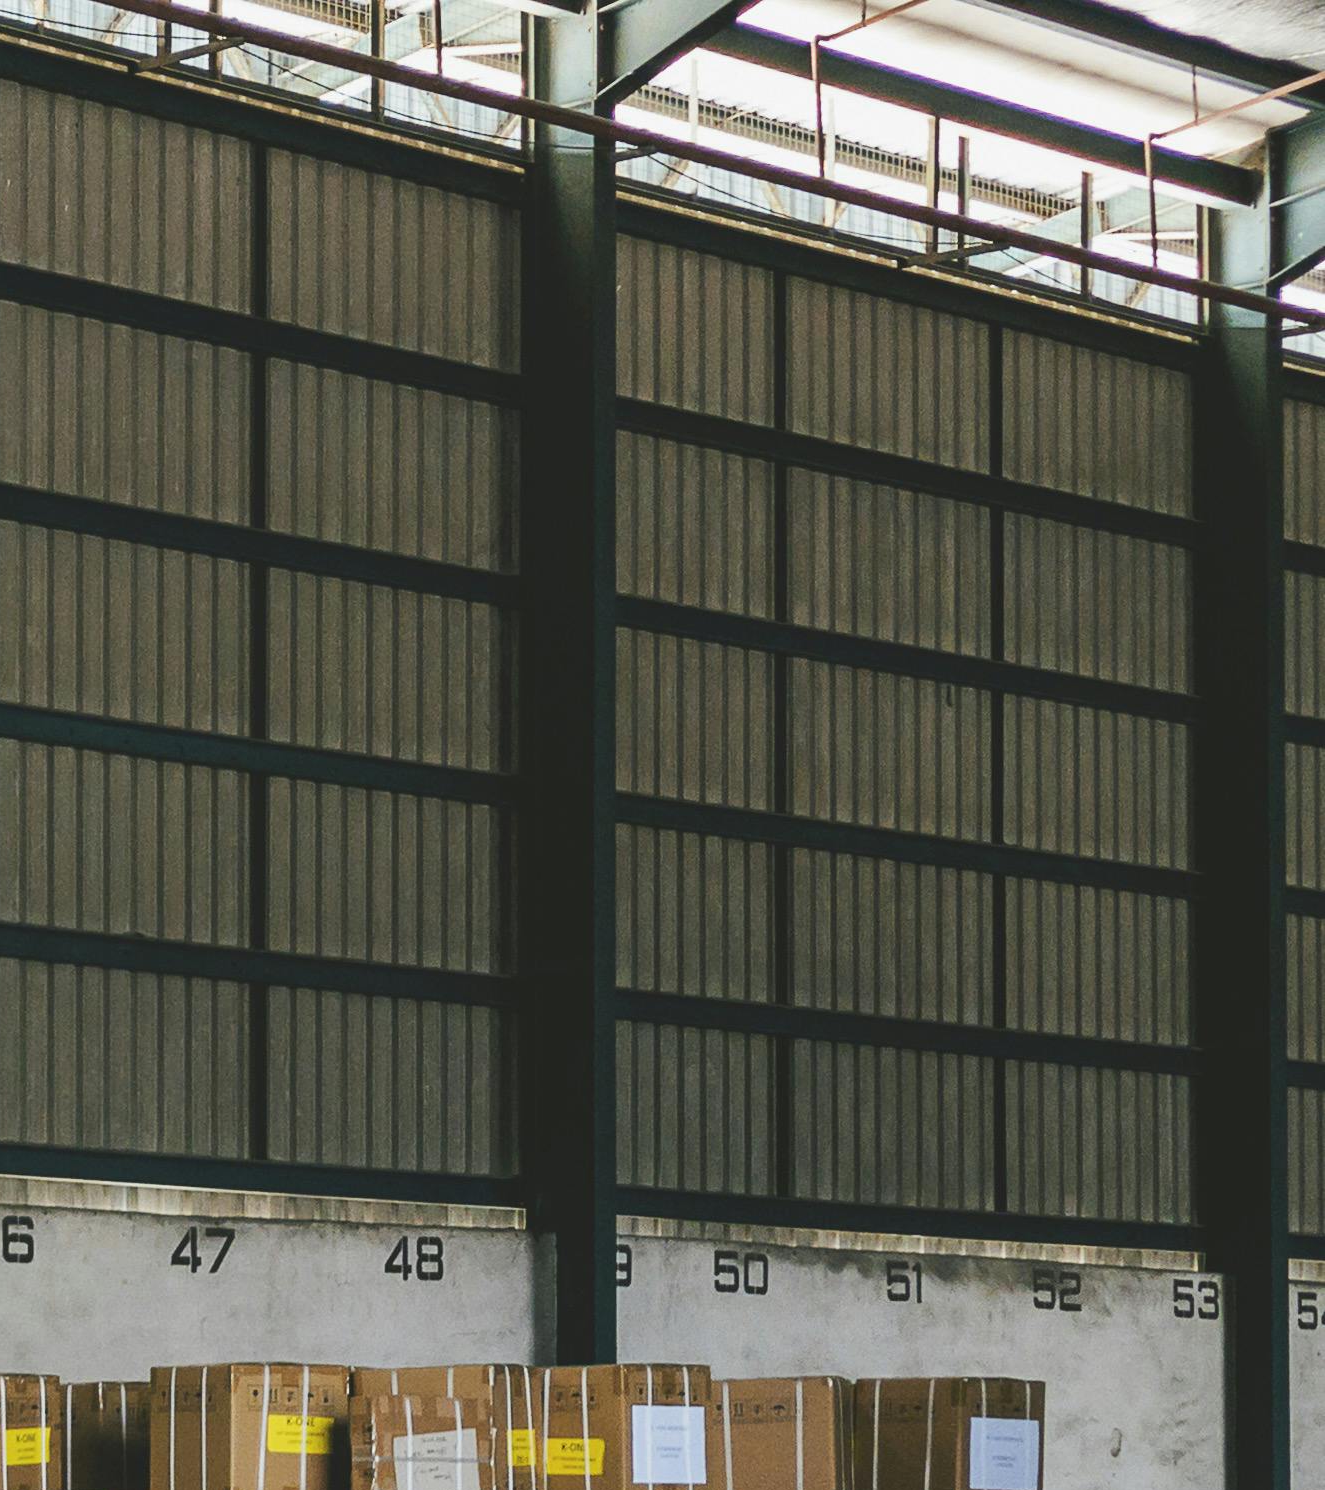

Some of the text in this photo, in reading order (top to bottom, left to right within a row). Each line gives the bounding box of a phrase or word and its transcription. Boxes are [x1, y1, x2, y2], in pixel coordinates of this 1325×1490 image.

[170, 1226, 236, 1274] 47
[384, 1235, 444, 1282] 48
[714, 1250, 769, 1295] 50
[886, 1260, 923, 1304] 51
[1033, 1268, 1082, 1312] 52
[1173, 1279, 1219, 1320] 53
[1297, 1292, 1325, 1330] 5
[15, 1434, 36, 1443] K-ONE
